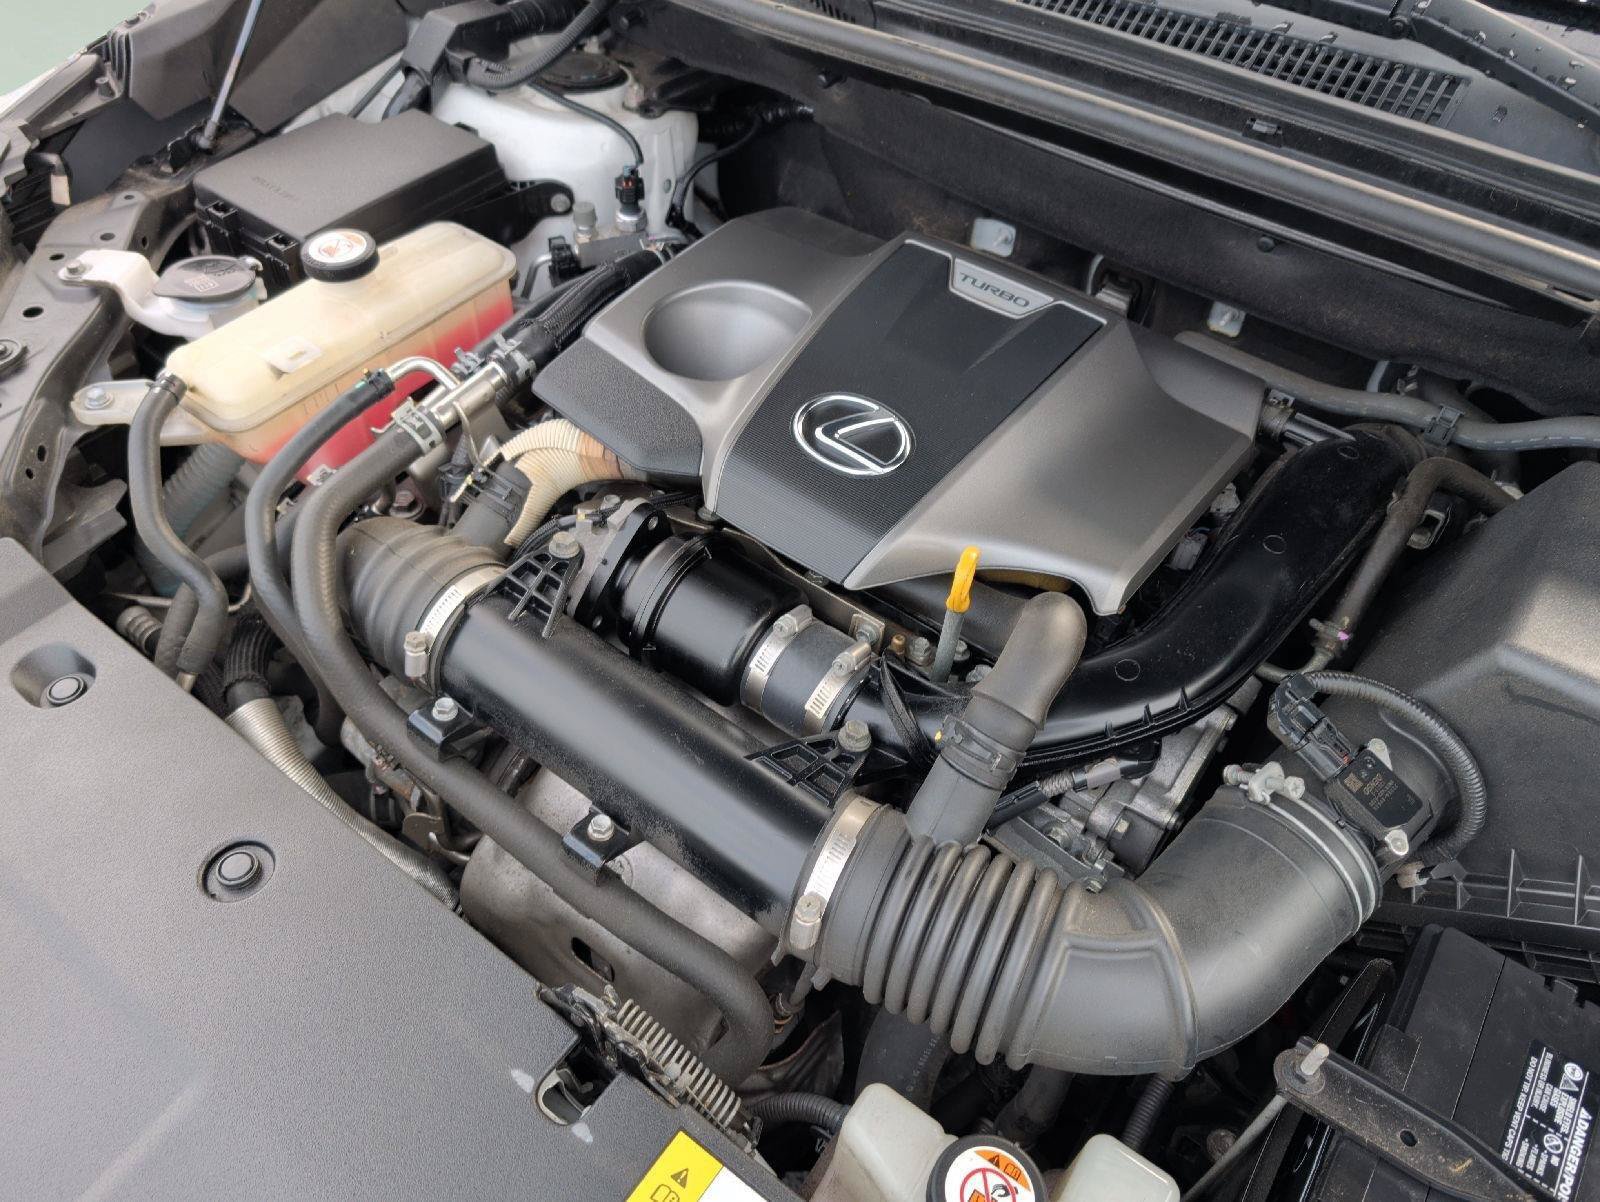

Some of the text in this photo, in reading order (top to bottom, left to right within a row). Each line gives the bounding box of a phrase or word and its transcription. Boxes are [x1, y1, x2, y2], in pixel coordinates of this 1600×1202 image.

[960, 272, 1030, 308] TURBO
[1529, 1056, 1538, 1067] DO
[1525, 1067, 1535, 1081] NOT
[1516, 1094, 1526, 1112] KEEP
[1510, 1112, 1521, 1129] VENT
[1504, 1129, 1516, 1148] CAPS
